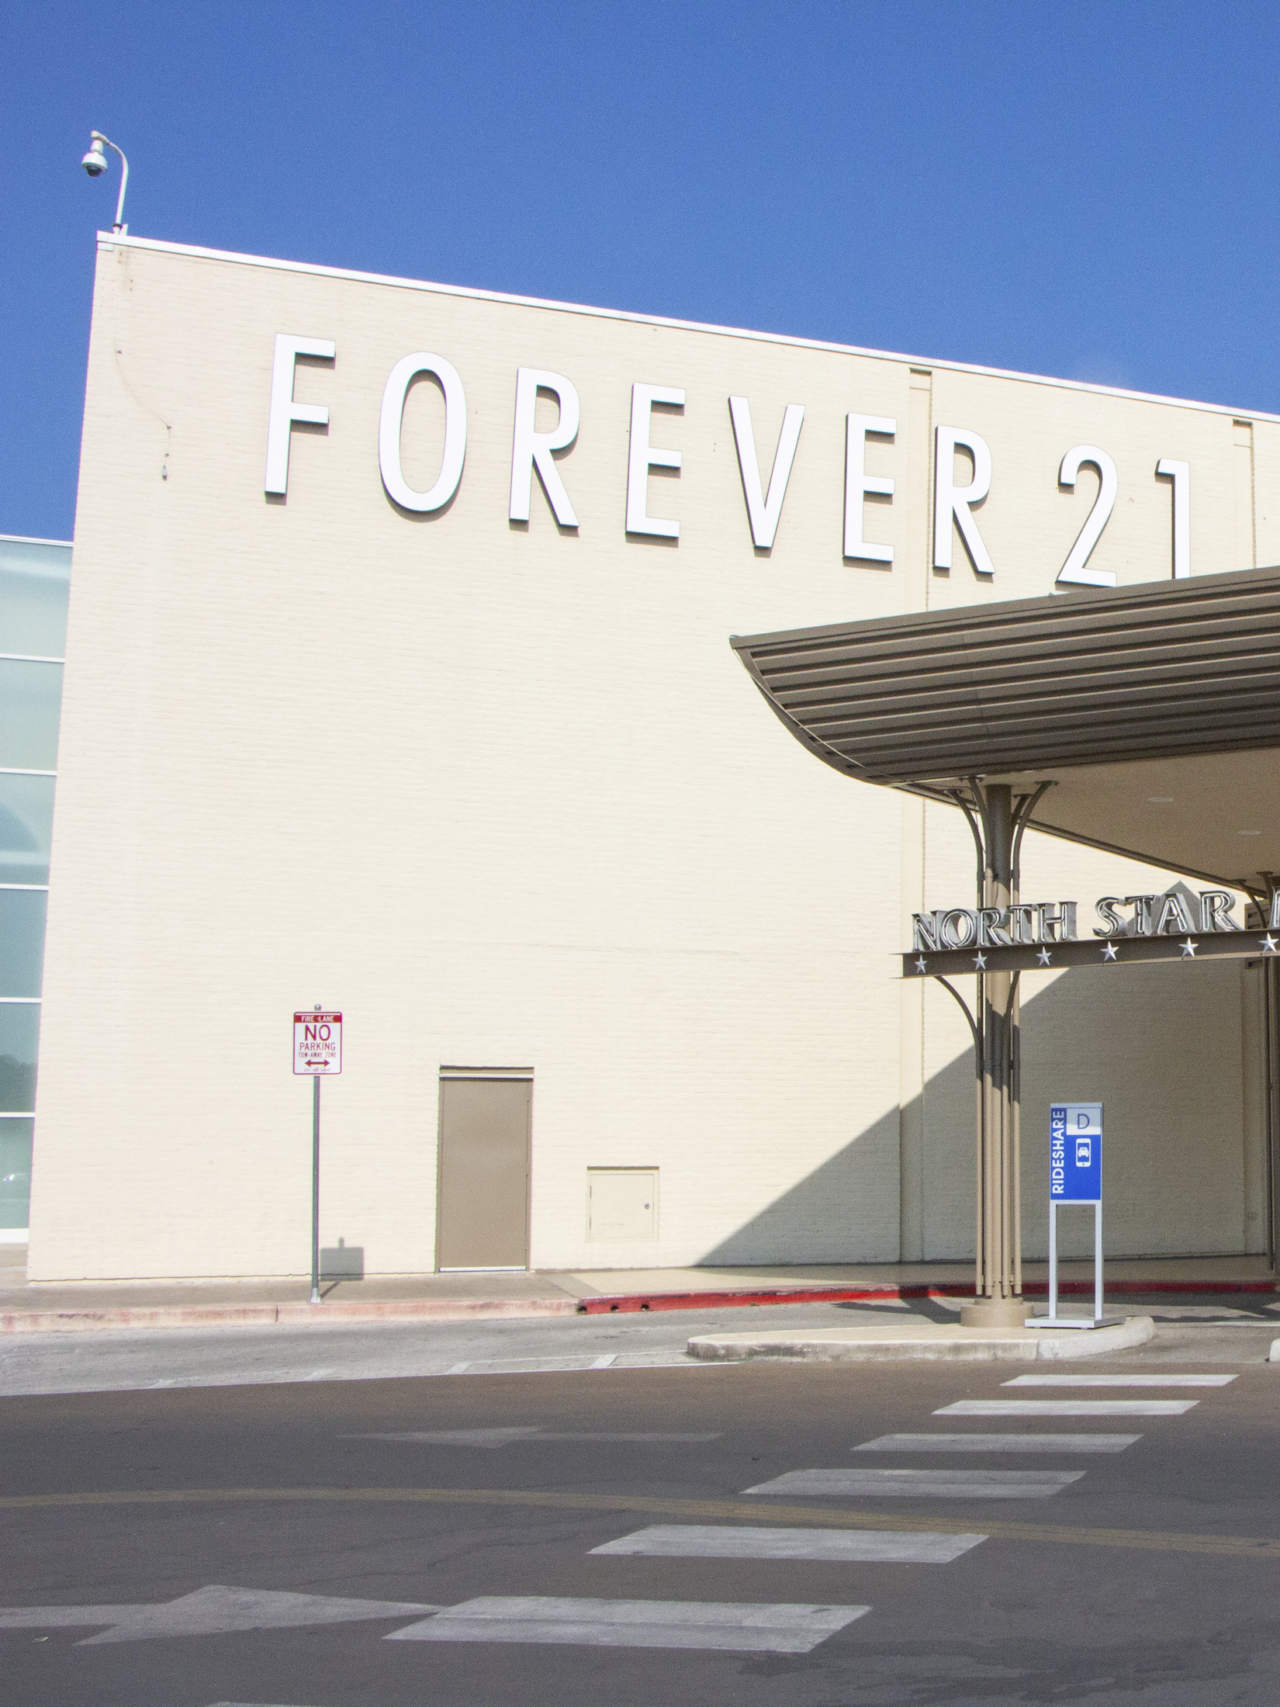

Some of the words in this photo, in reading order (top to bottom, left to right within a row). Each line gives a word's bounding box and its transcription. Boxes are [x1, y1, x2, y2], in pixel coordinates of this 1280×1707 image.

[265, 333, 995, 575] FOREVER
[1055, 444, 1191, 588] 21
[912, 901, 1077, 952] NORTH
[1092, 890, 1243, 937] STAR
[299, 1042, 336, 1051] PARKING
[304, 1024, 331, 1041] NO
[1077, 1113, 1090, 1129] D
[1052, 1110, 1064, 1194] RIDESHARE
